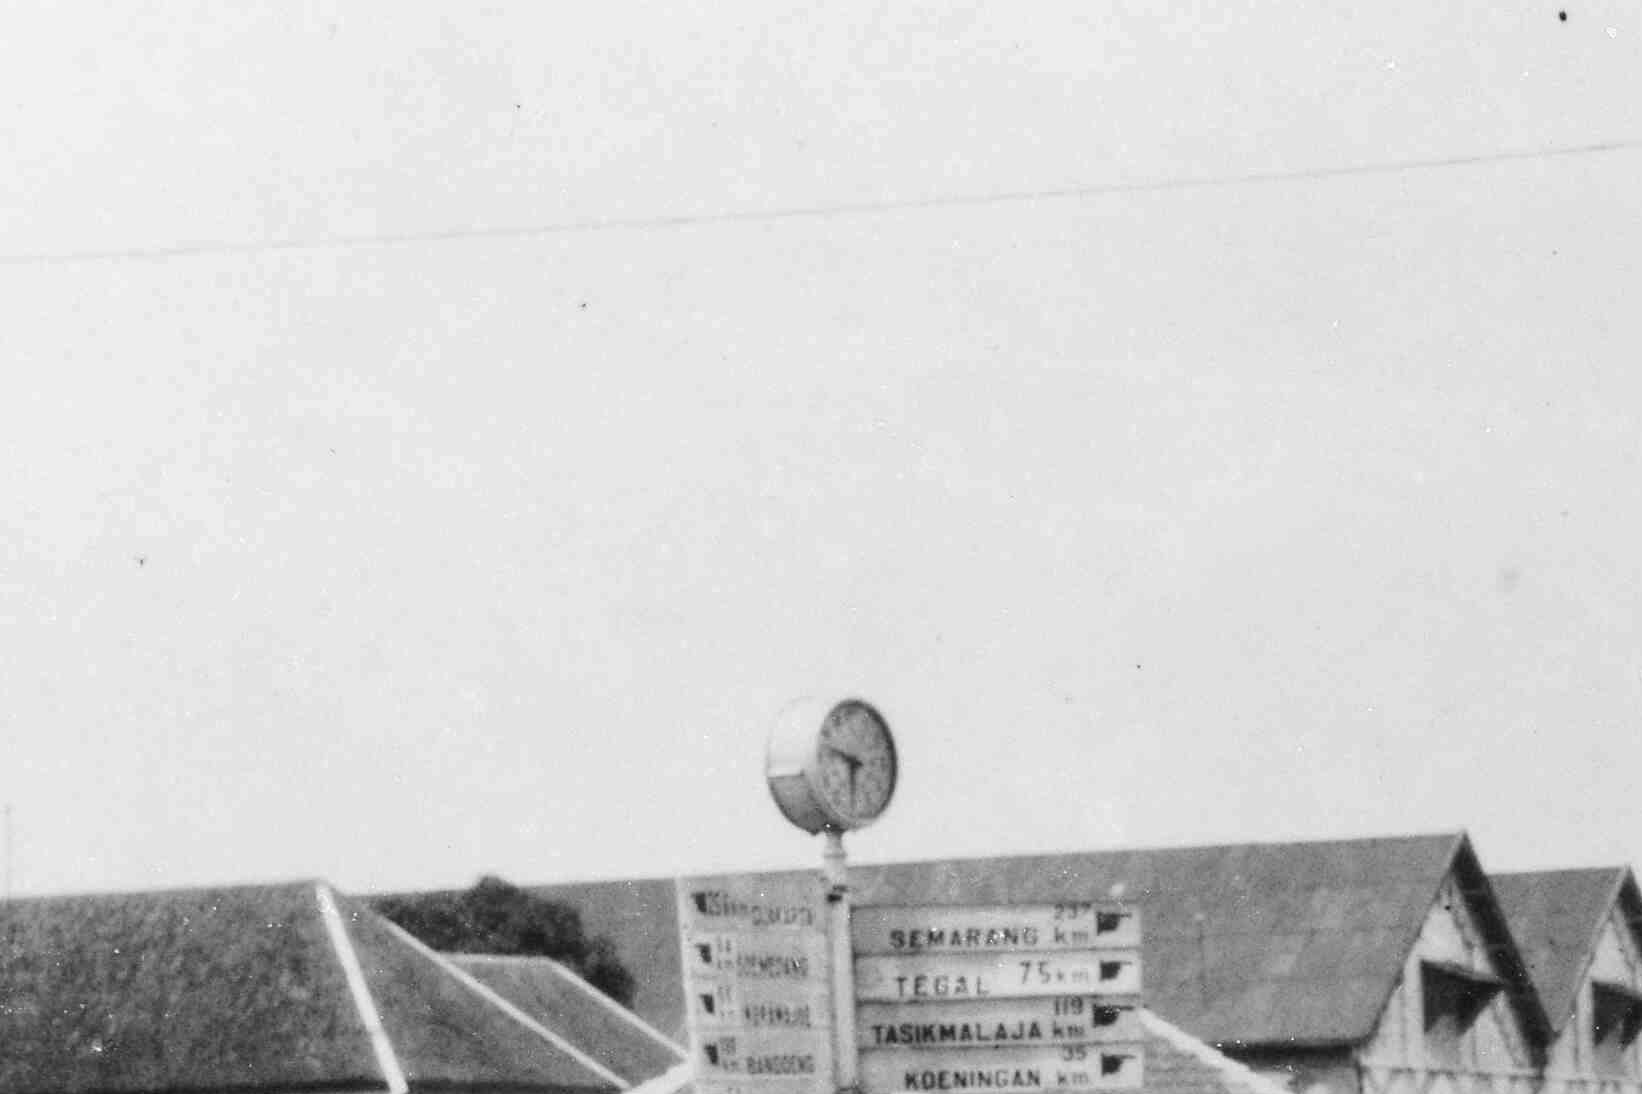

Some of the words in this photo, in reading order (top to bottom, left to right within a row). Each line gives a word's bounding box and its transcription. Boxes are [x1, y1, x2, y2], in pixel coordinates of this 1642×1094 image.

[890, 928, 1039, 949] SEMARANG
[1055, 926, 1089, 944] km
[896, 975, 990, 997] TEGAL
[1019, 960, 1051, 984] 75
[1054, 996, 1084, 1016] 119
[871, 1022, 1043, 1044] TASIKMALAJA
[1053, 1021, 1085, 1039] km
[905, 1069, 1042, 1090] KOENINGAN
[1057, 1071, 1089, 1087] km
